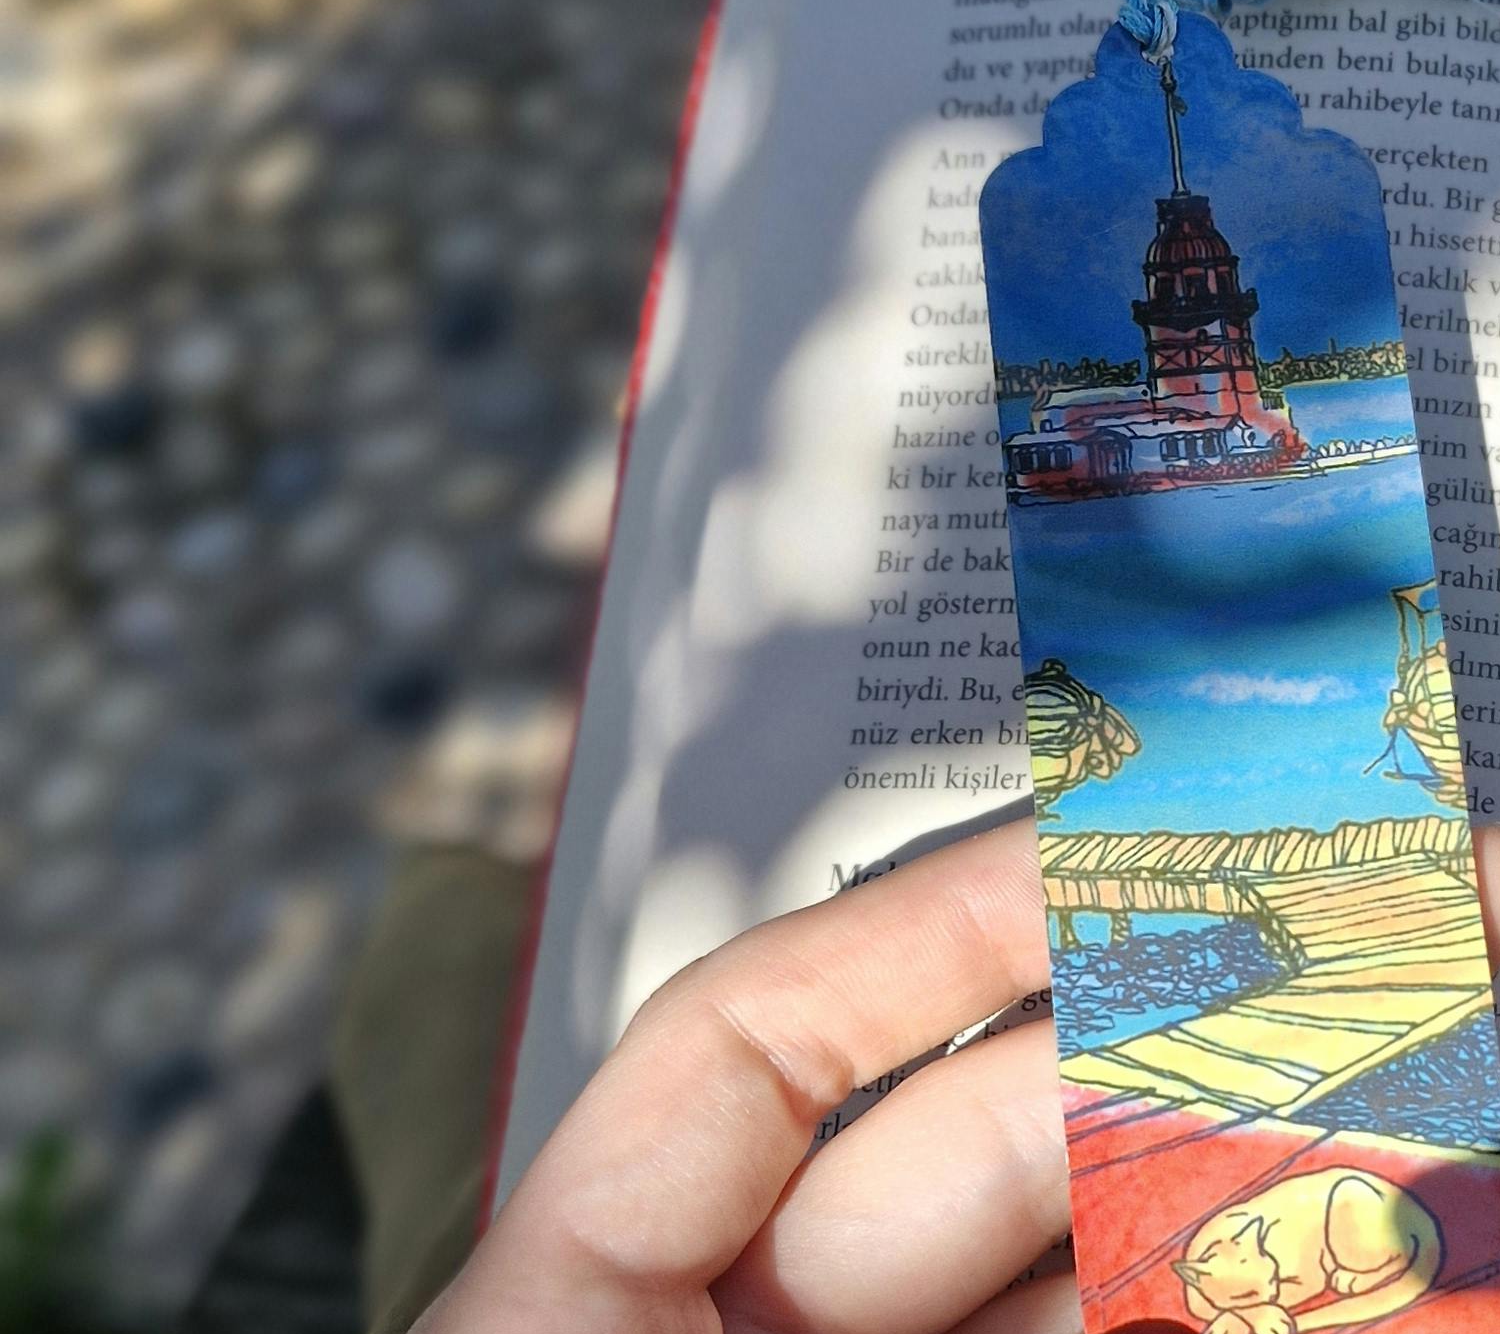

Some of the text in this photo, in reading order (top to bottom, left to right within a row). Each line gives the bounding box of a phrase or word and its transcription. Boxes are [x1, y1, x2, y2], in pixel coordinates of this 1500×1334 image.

[1349, 12, 1446, 41] bal gibi
[1338, 51, 1394, 73] beni
[1407, 53, 1500, 84] bulaşık
[1320, 91, 1443, 122] rahibeyle
[1446, 187, 1481, 214] Bir
[905, 343, 987, 367] sürekli
[893, 425, 976, 449] hazine
[876, 549, 954, 573] Bir de
[868, 593, 907, 622] yol
[863, 638, 970, 659] onun ne
[858, 677, 1001, 709] biriydi. Bu,
[851, 721, 983, 745] nüz erken
[844, 764, 1026, 795] önemli kişiler
